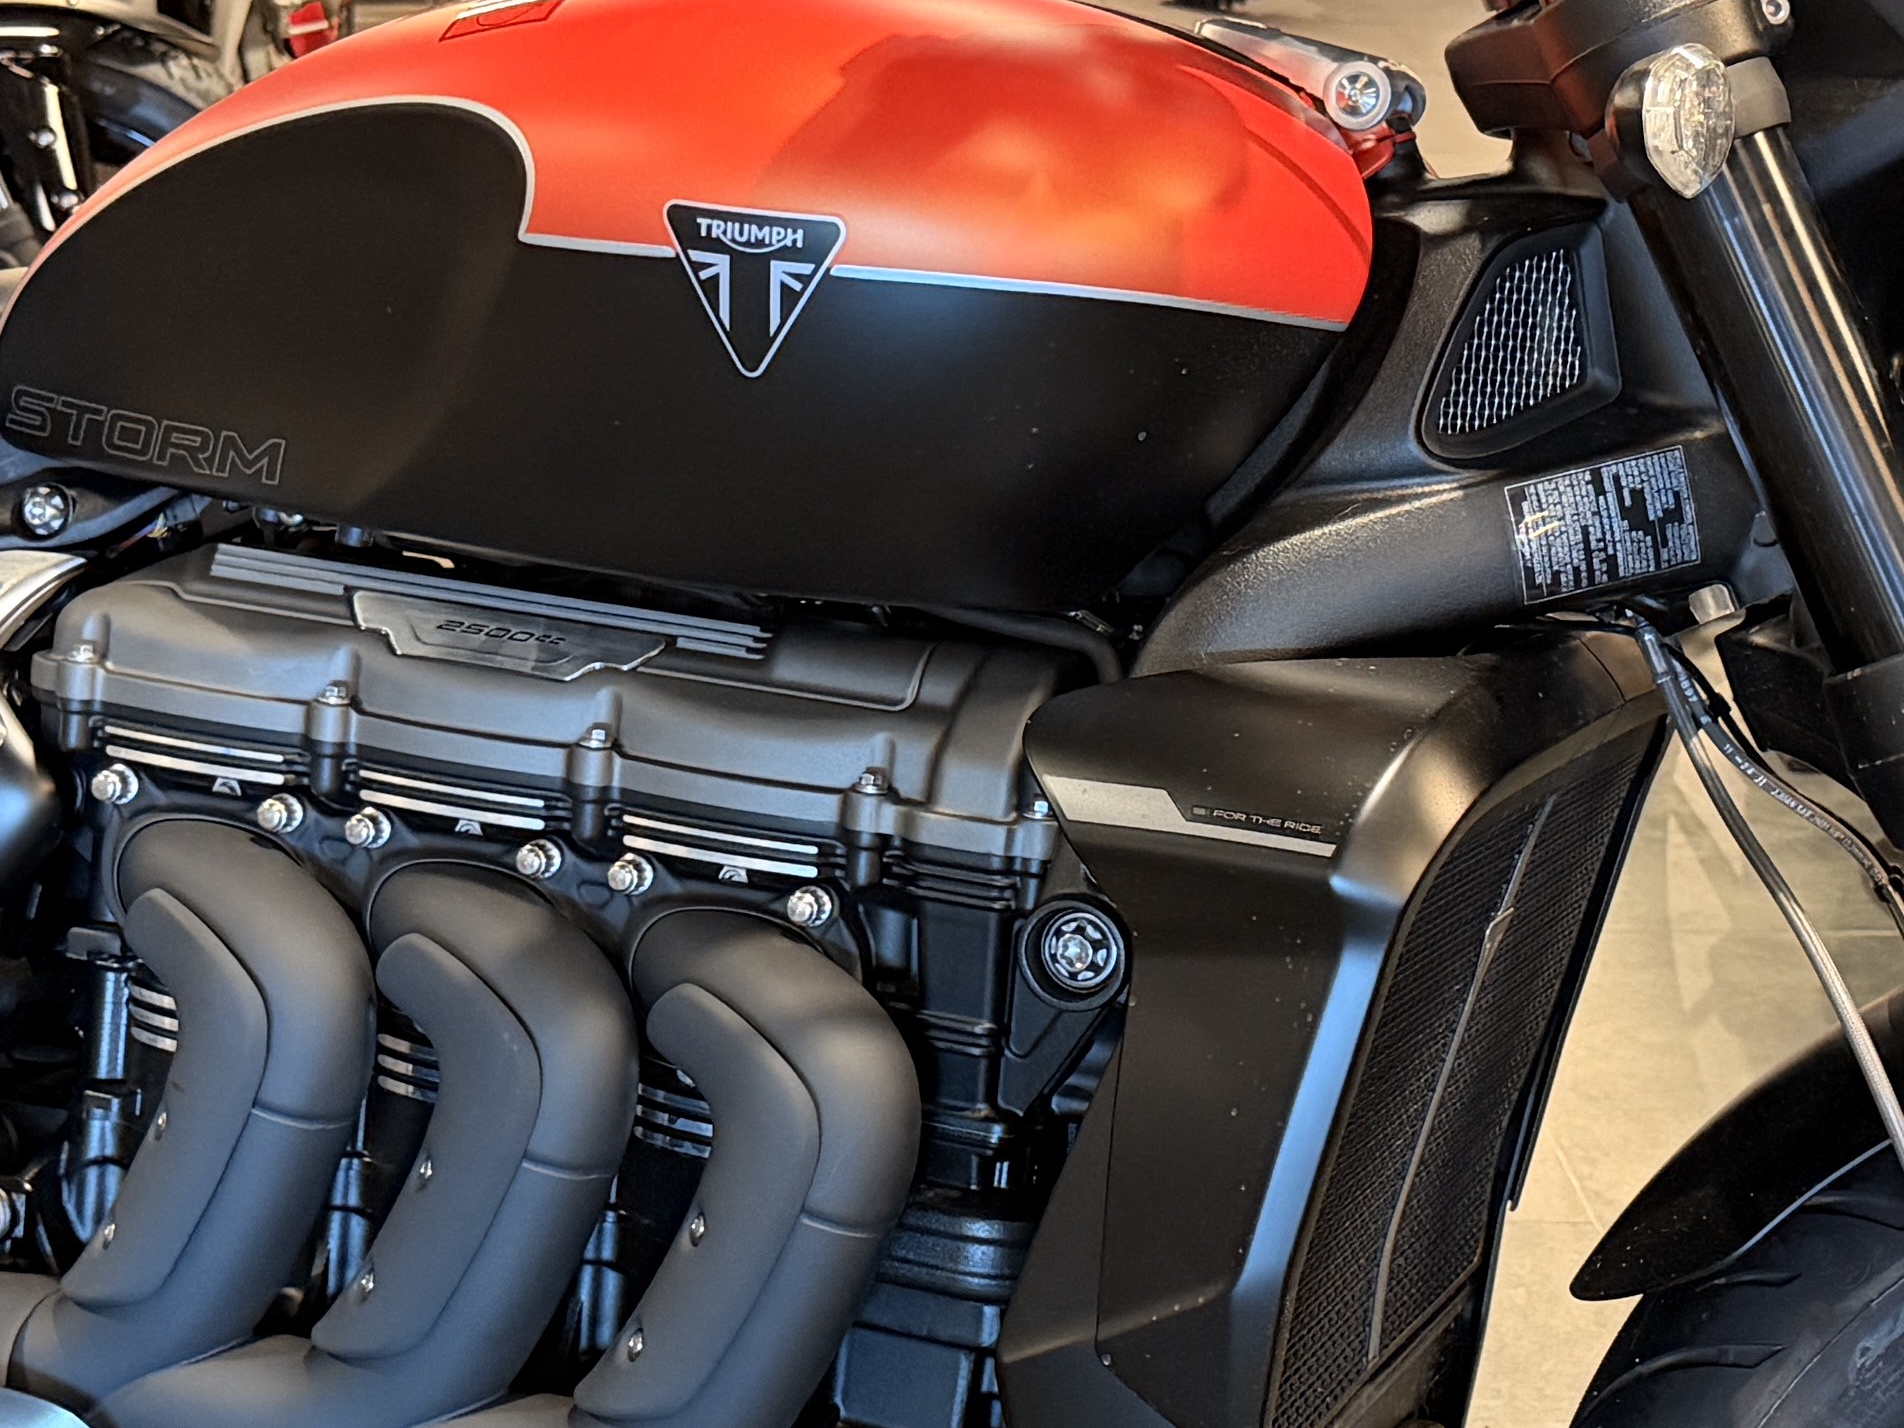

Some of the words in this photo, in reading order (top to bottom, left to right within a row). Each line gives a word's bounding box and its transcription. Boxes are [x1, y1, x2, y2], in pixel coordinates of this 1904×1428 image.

[697, 217, 804, 254] TRIUMPH
[5, 384, 286, 485] STORM
[436, 619, 568, 645] 2500cc
[1212, 809, 1247, 822] FOR
[1250, 814, 1282, 828] THE
[1284, 820, 1322, 835] RIDE
